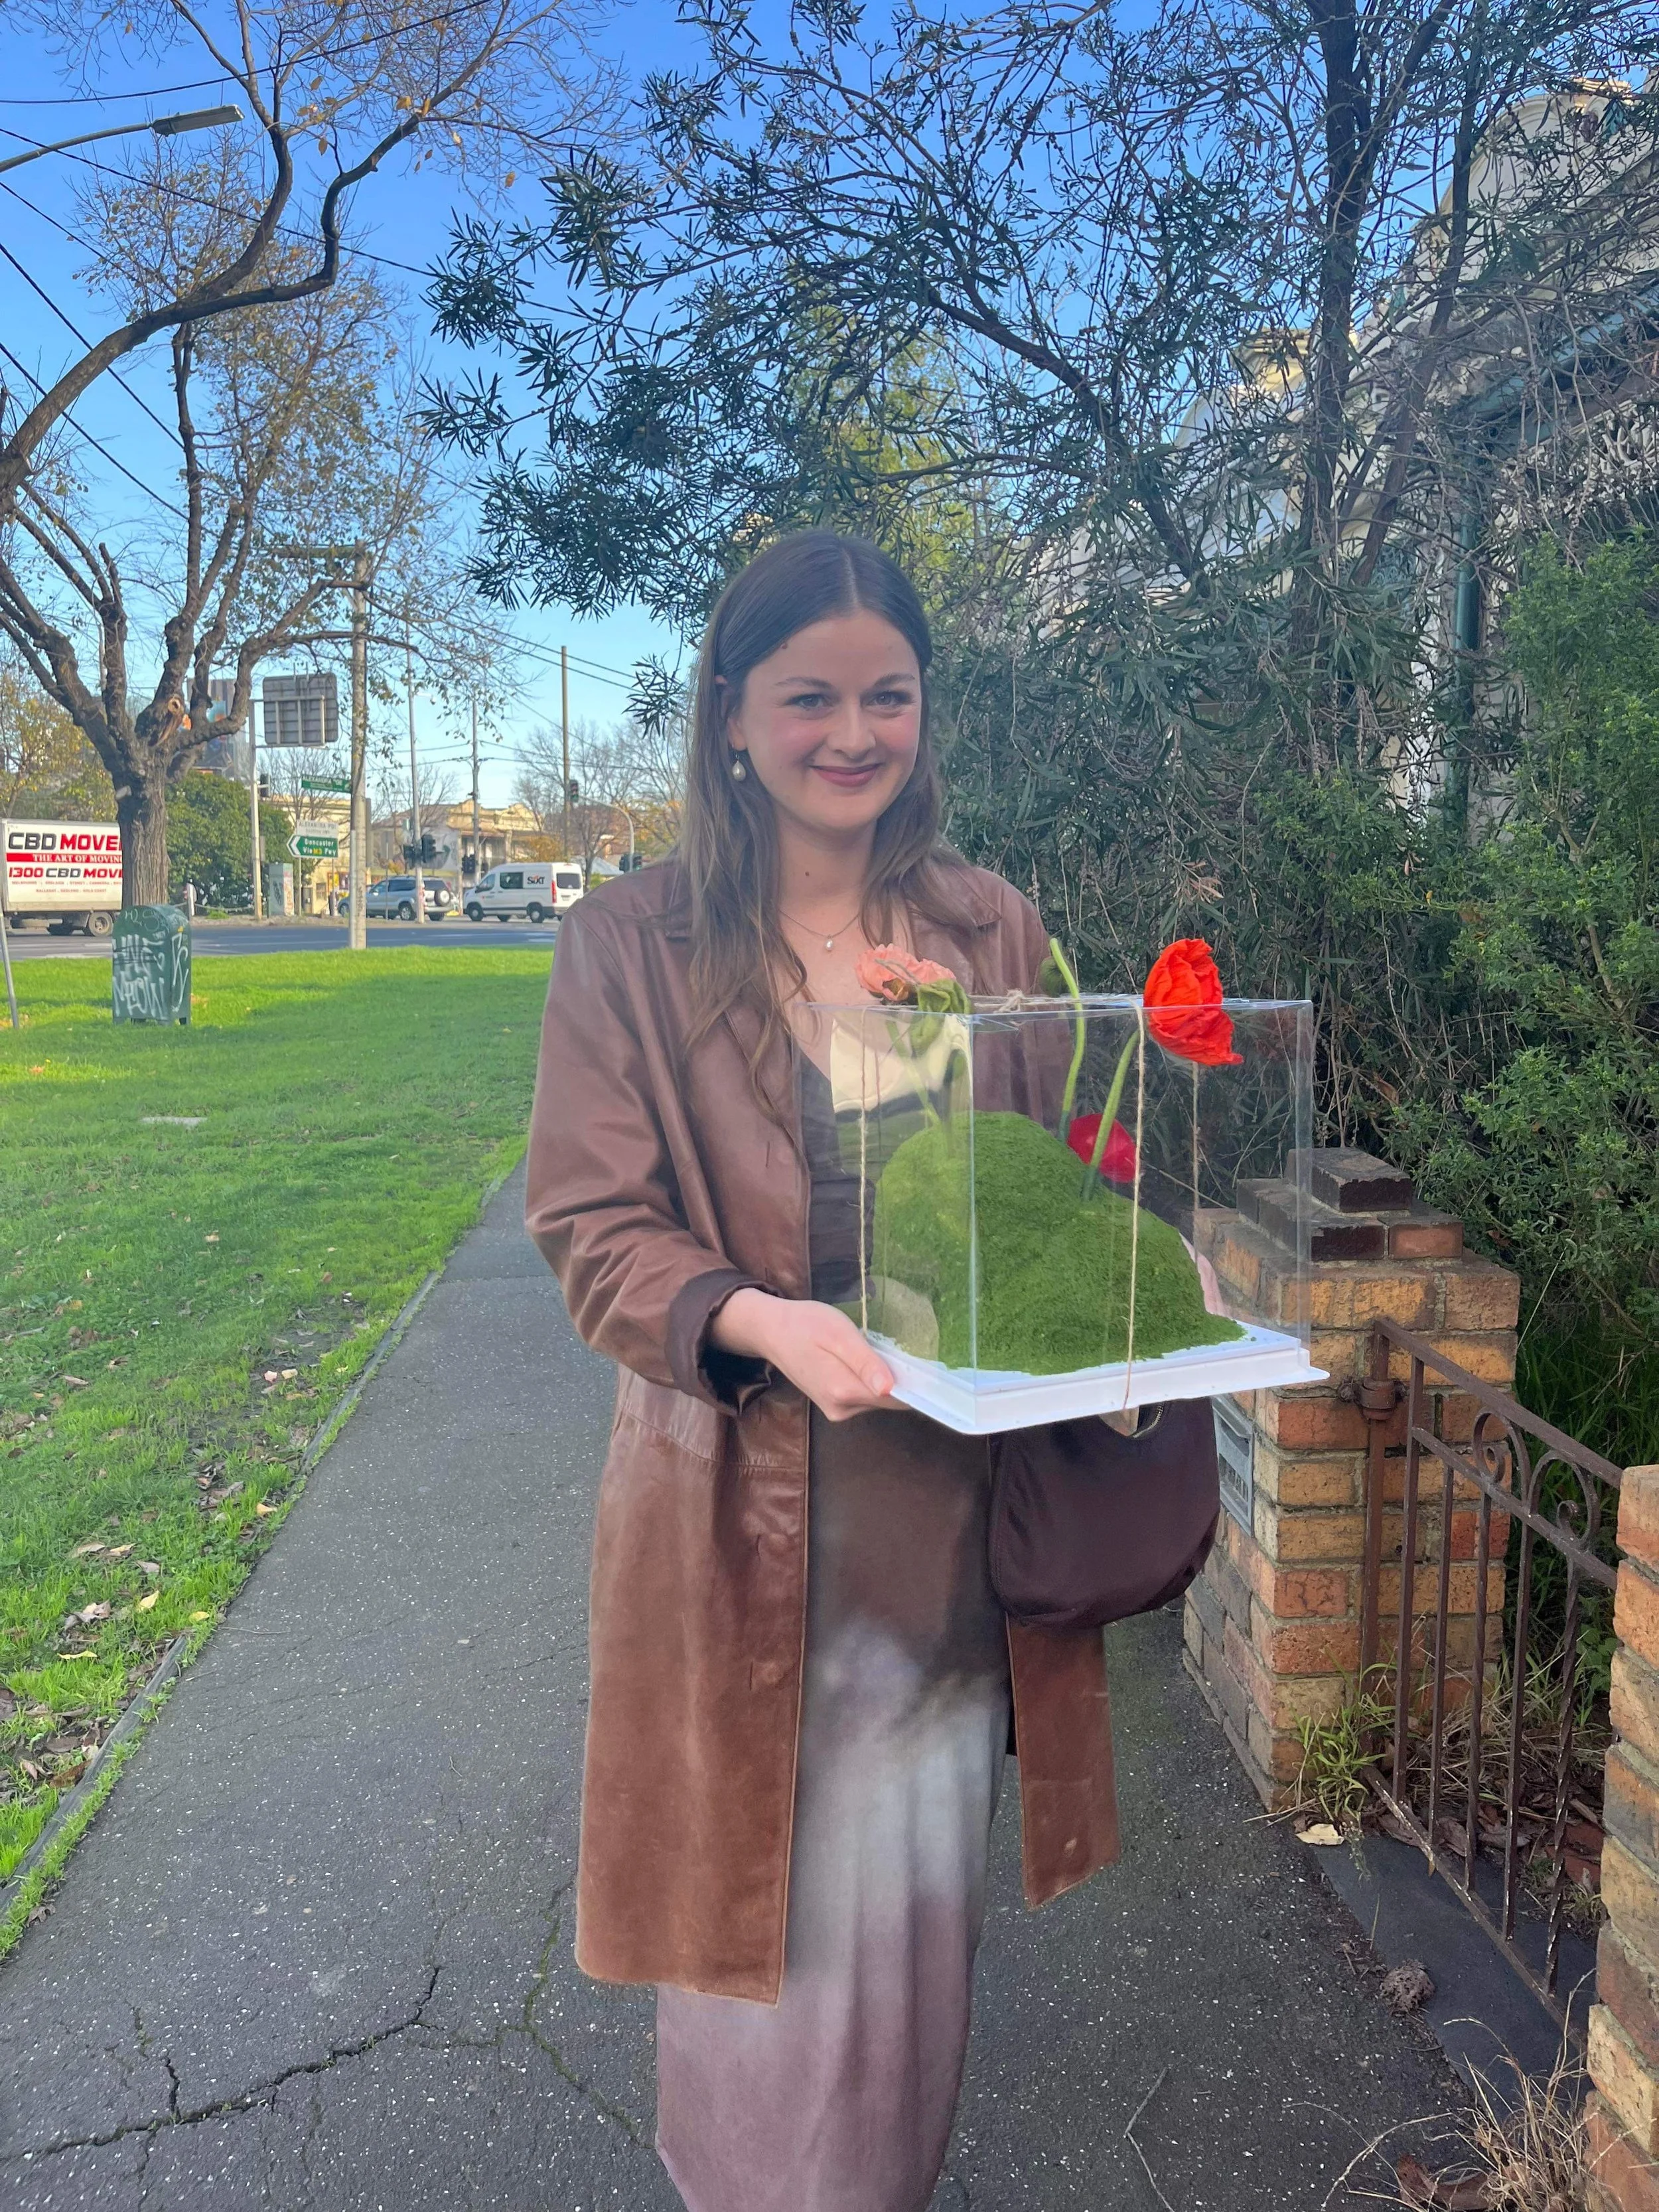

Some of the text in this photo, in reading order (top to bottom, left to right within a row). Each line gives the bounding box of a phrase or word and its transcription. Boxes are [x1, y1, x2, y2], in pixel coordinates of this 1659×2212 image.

[9, 832, 122, 851] CBD MOVE
[305, 838, 334, 847] Doncaster
[9, 867, 44, 878] 1300
[46, 867, 81, 878] CBD
